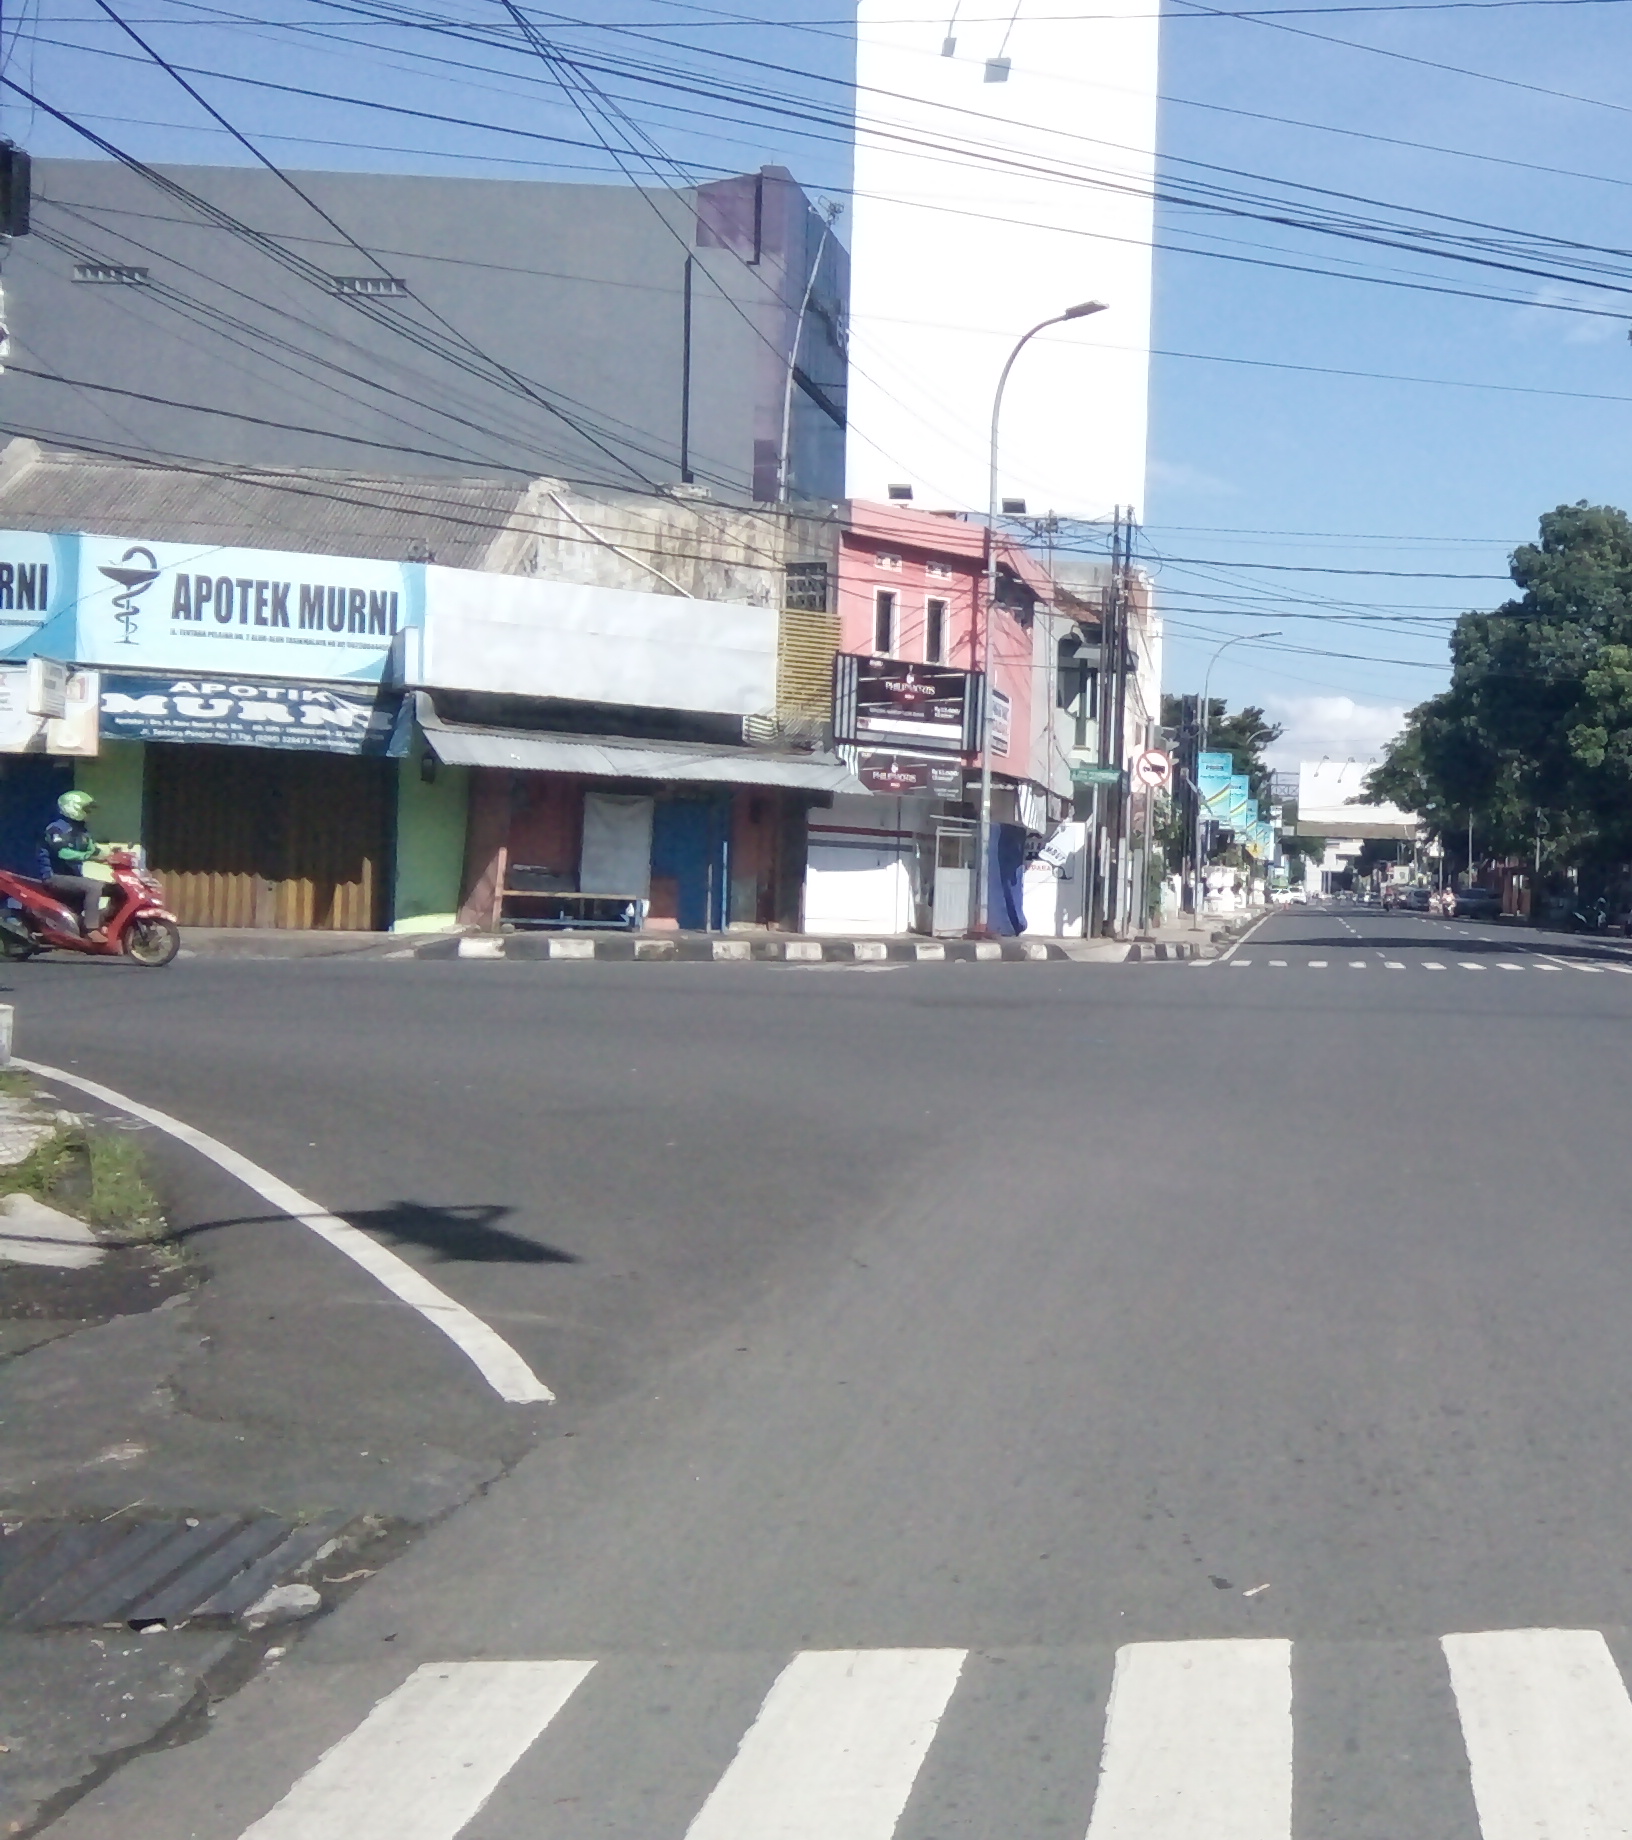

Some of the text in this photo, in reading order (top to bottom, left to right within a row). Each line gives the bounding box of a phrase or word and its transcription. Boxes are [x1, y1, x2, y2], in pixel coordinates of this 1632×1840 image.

[171, 572, 399, 636] APOTEK MURNI
[169, 681, 330, 703] APOTIK
